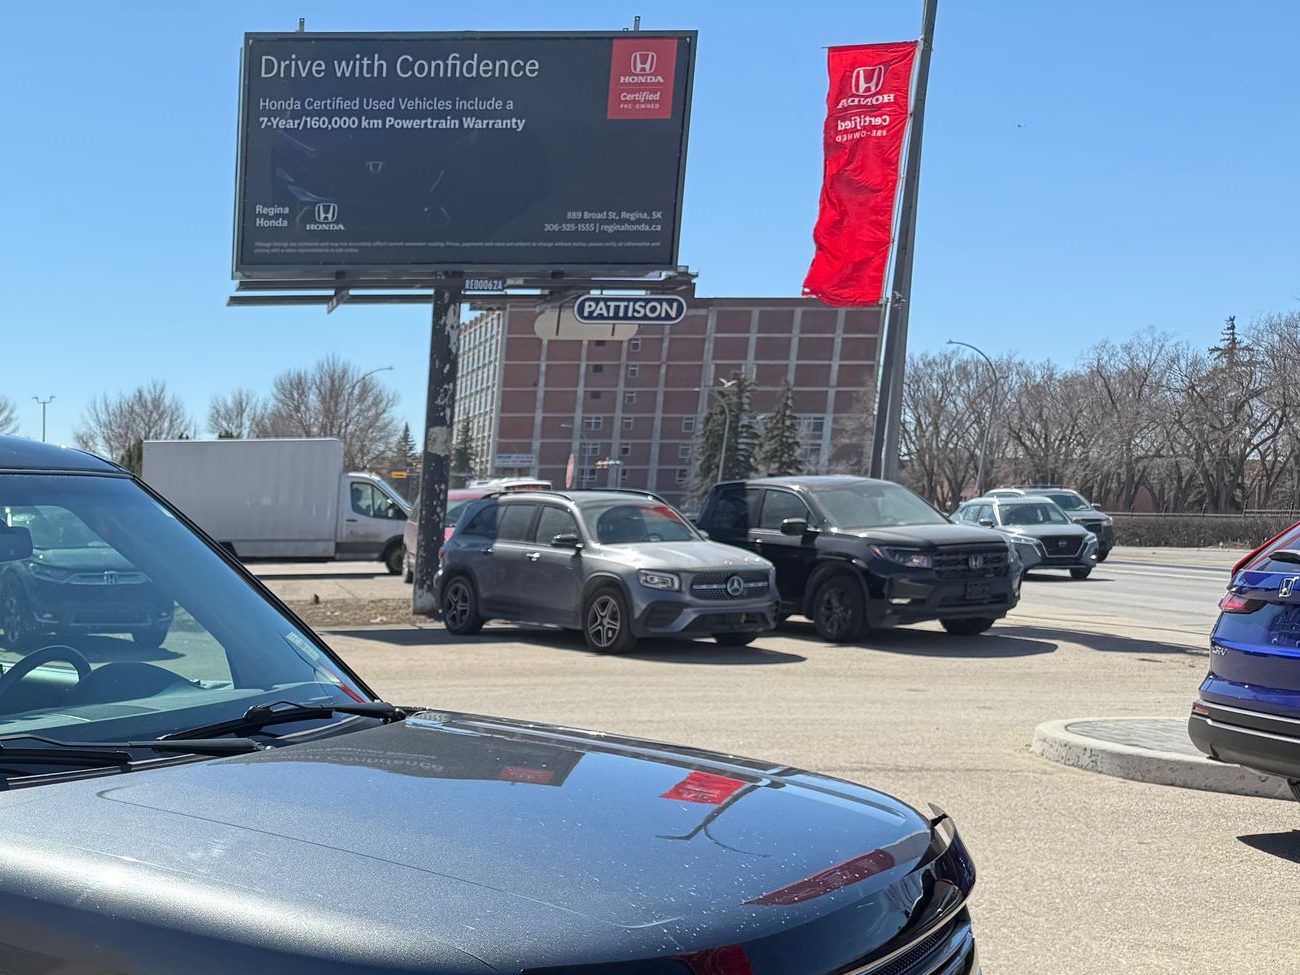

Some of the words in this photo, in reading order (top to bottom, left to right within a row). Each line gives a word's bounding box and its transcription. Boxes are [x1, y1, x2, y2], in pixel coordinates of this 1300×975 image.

[261, 54, 325, 78] Drive
[334, 53, 387, 78] with
[396, 52, 539, 78] Confidence
[620, 75, 664, 83] HONDA
[620, 91, 661, 103] Certified
[259, 97, 301, 110] Honda
[304, 97, 359, 110] Certified
[363, 97, 394, 110] Used
[399, 97, 452, 110] Vehicles
[455, 97, 503, 110] include
[506, 100, 514, 110] a
[259, 116, 358, 130] 7-Year/160,000
[361, 116, 382, 129] km
[385, 116, 459, 129] Powertrain
[462, 117, 525, 132] Warranty
[255, 205, 289, 216] Regina
[583, 211, 607, 219] Broad
[652, 211, 662, 219] SK
[256, 217, 288, 227] Honda
[601, 223, 661, 233] reginahonda.ca
[583, 301, 678, 318] PATTISON
